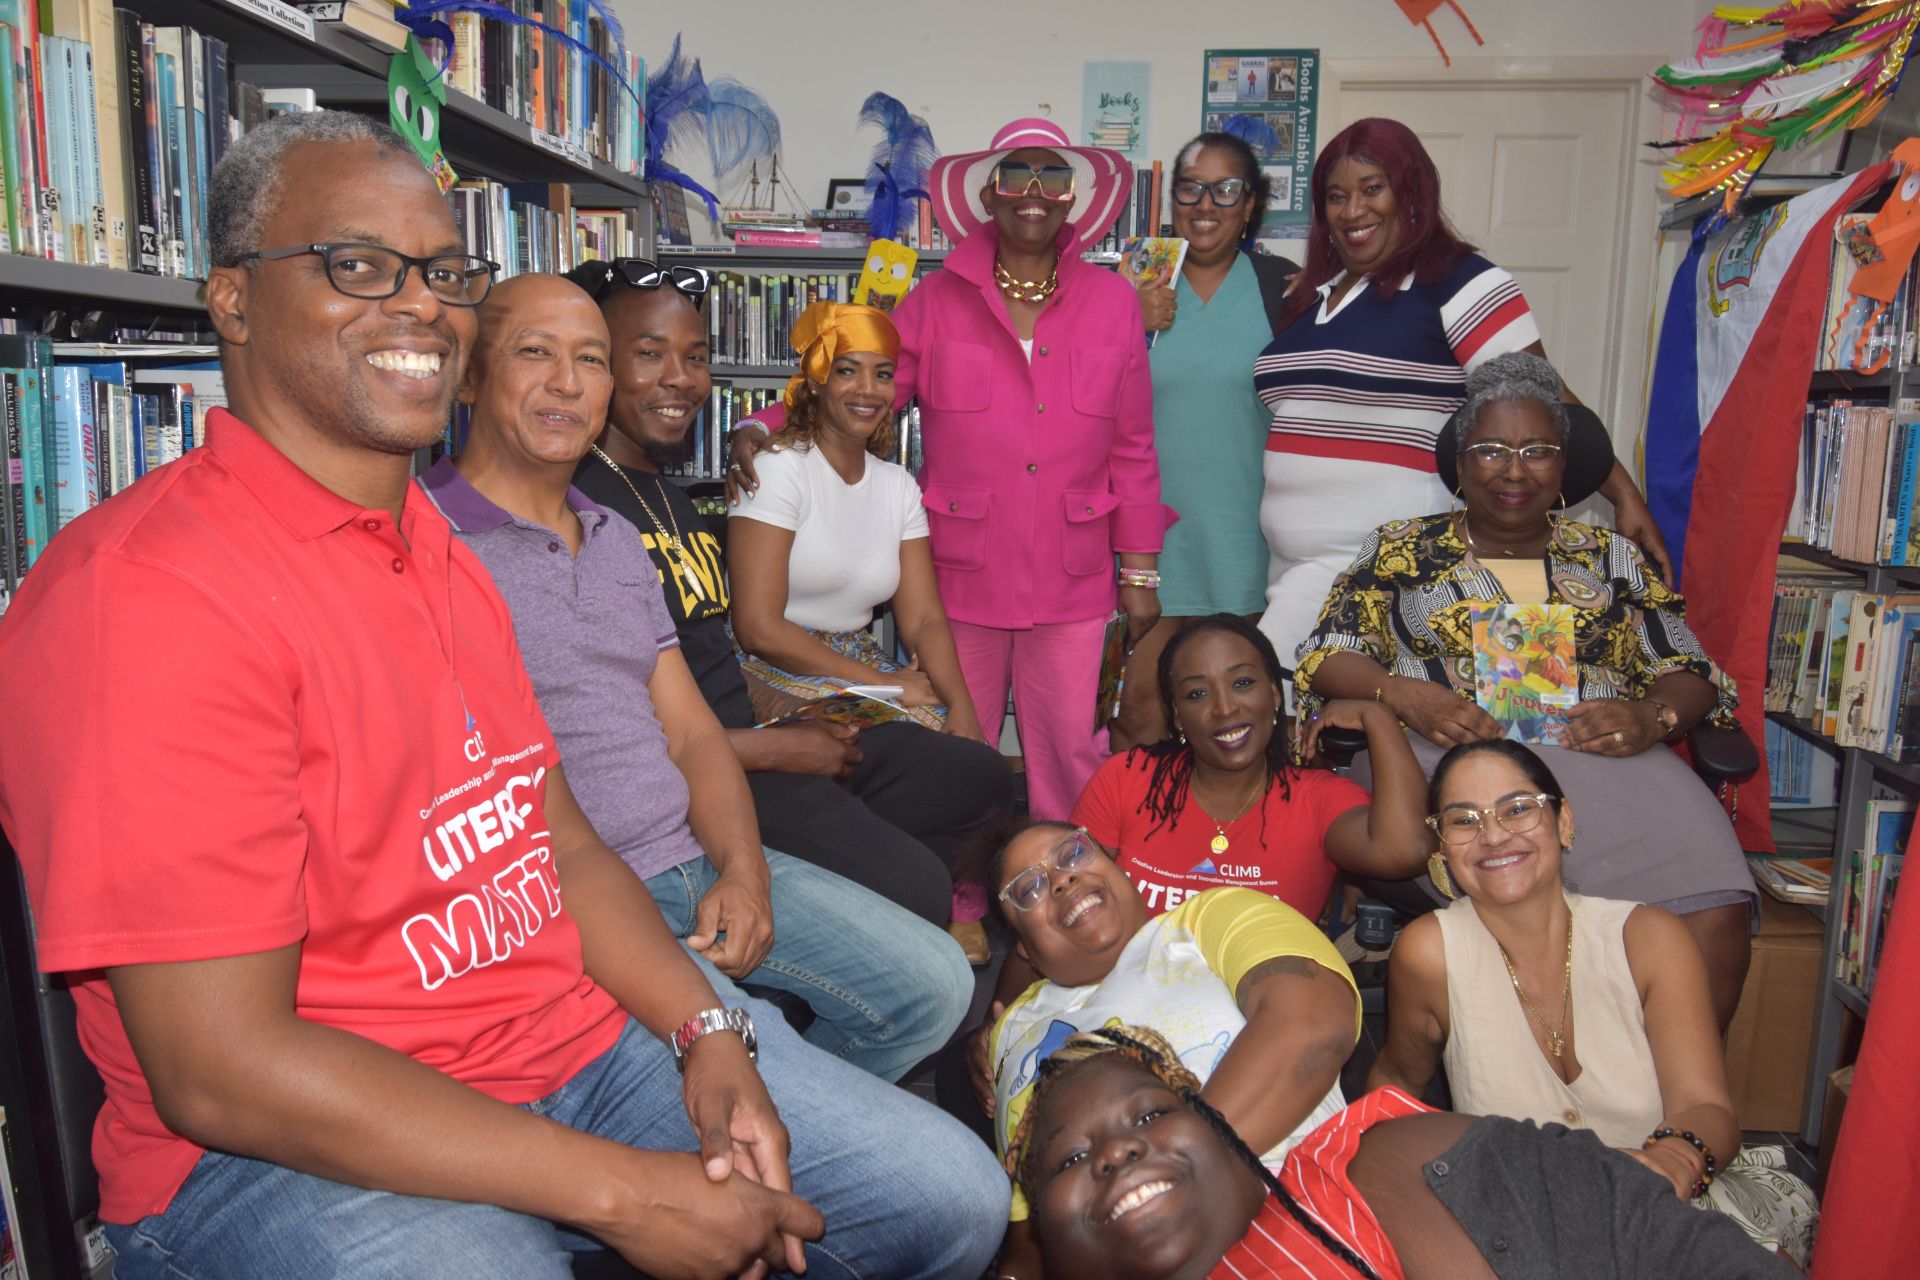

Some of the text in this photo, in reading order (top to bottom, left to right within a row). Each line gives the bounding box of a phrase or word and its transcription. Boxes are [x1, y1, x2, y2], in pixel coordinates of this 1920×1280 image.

[271, 5, 306, 30] Collection
[131, 49, 141, 108] BITTEN
[1098, 91, 1142, 112] Books
[1294, 57, 1314, 212] Books Available Here
[7, 383, 17, 454] BILLINGSLEY
[183, 402, 193, 435] Caribbean
[83, 423, 95, 465] ONLY
[16, 488, 26, 547] SEEKING
[1897, 493, 1908, 537] MAARTEN
[1496, 687, 1565, 718] J'ouver
[434, 776, 482, 807] Leadership
[1131, 857, 1153, 872] Creative
[1153, 866, 1185, 880] Leadership
[1198, 875, 1225, 885] Innovation
[1224, 879, 1259, 888] Management
[1219, 864, 1262, 879] CLIMB
